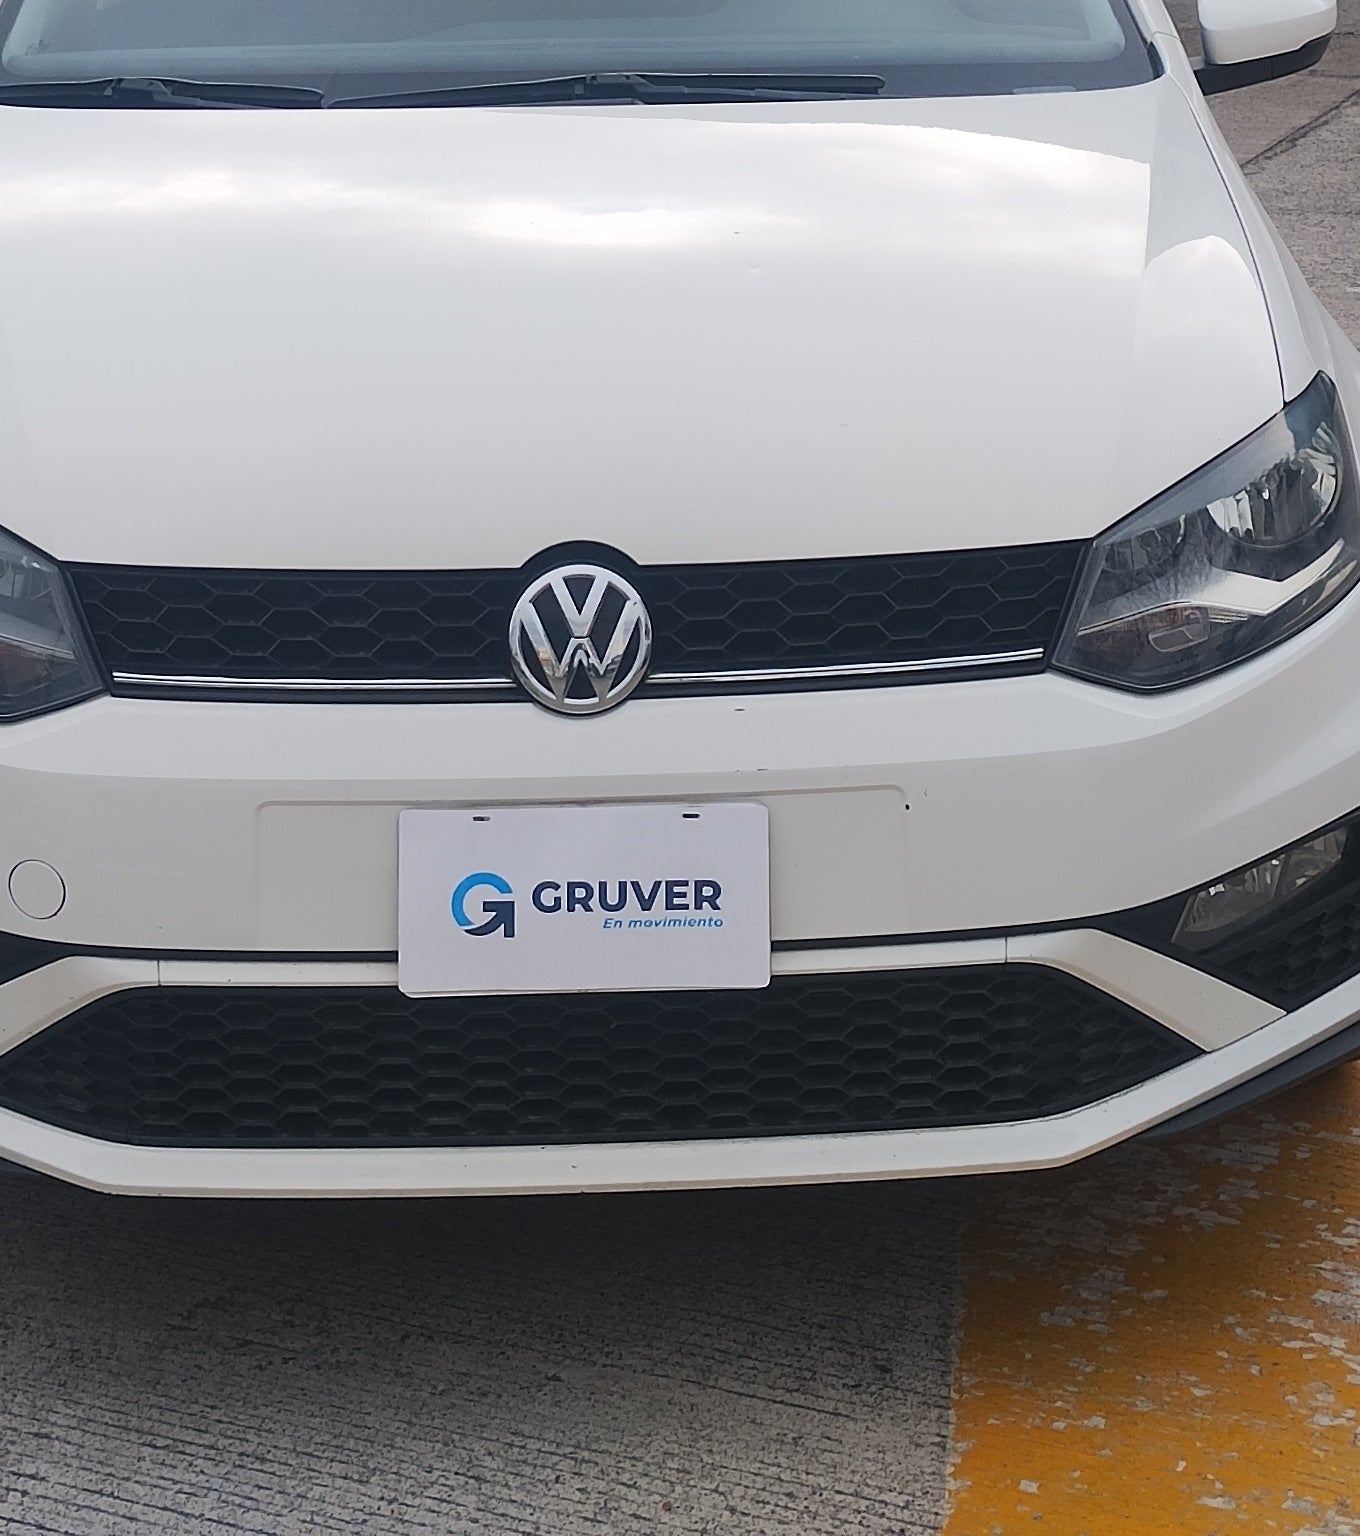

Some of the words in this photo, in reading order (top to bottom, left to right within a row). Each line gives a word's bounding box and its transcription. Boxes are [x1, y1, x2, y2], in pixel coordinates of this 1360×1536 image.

[531, 878, 723, 914] GRUVER
[602, 917, 623, 929] En
[628, 915, 724, 929] movimiento
